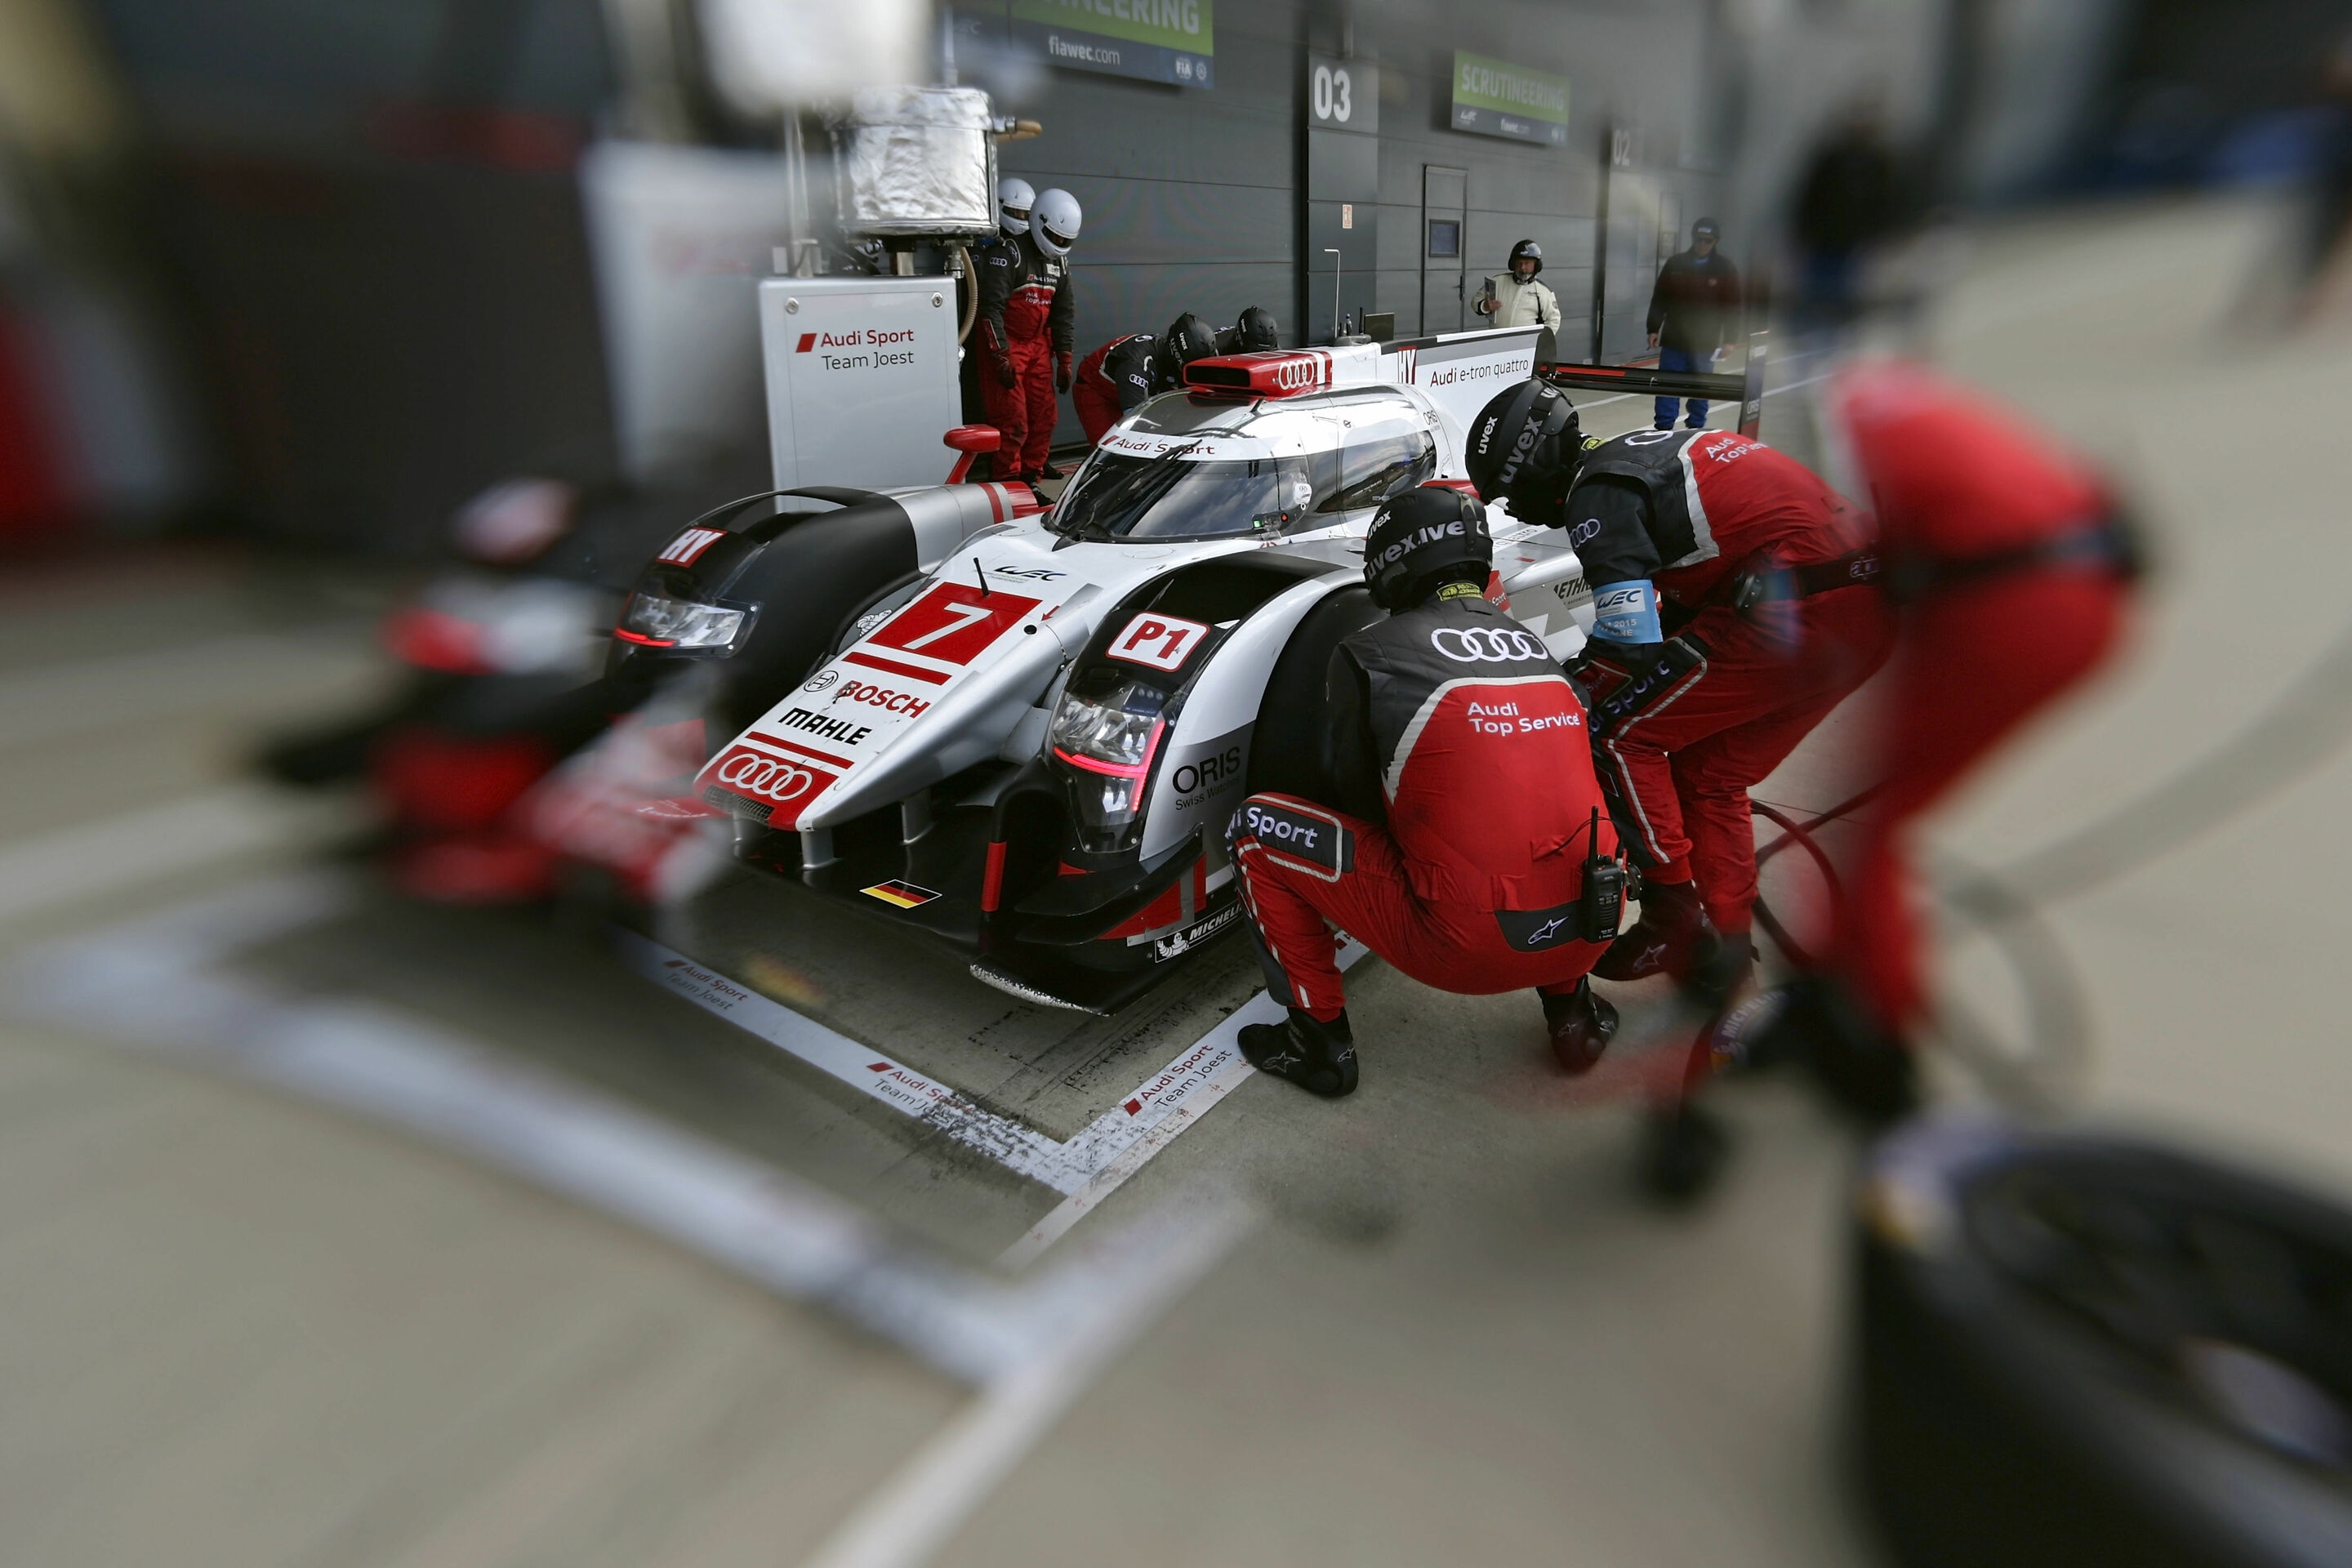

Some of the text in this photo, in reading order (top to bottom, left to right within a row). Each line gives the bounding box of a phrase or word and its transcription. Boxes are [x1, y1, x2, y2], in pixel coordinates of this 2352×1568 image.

[1049, 35, 1120, 65] fiawec.com
[1314, 65, 1352, 122] 03
[1461, 64, 1566, 111] SCRUTINEERING
[1613, 130, 1632, 167] 02
[821, 329, 915, 347] Audi Sport
[1179, 332, 1188, 350] uvex
[822, 351, 915, 370] Team Joest
[1398, 349, 1416, 385] HY
[1430, 359, 1530, 388] Audi e-tron quattro
[1113, 438, 1216, 456] Audi Sort
[1477, 416, 1499, 455] uvex
[1498, 415, 1544, 484] uvex
[1368, 510, 1392, 538] uvex
[658, 528, 725, 564] HY
[993, 565, 1068, 582] WEC
[1597, 590, 1642, 609] WEC
[901, 601, 995, 651] 7
[1122, 620, 1191, 660] P1
[1614, 618, 1637, 628] 2015
[836, 680, 931, 719] BOSCH
[1467, 702, 1519, 716] Audi
[777, 707, 873, 746] MAHLE
[1468, 719, 1513, 737] Top
[1518, 712, 1581, 733] Service
[1172, 746, 1241, 794] ORIS
[1175, 794, 1205, 811] Swiss
[1246, 806, 1318, 849] Sport
[1189, 902, 1242, 941] MICHELI
[667, 973, 734, 1010] Team Joest
[681, 966, 749, 1001] Audi Sport
[889, 1071, 929, 1091] Audi
[1141, 1045, 1214, 1102] Audi Sport
[1154, 1049, 1233, 1107] Team Joest
[874, 1078, 916, 1106] Team
